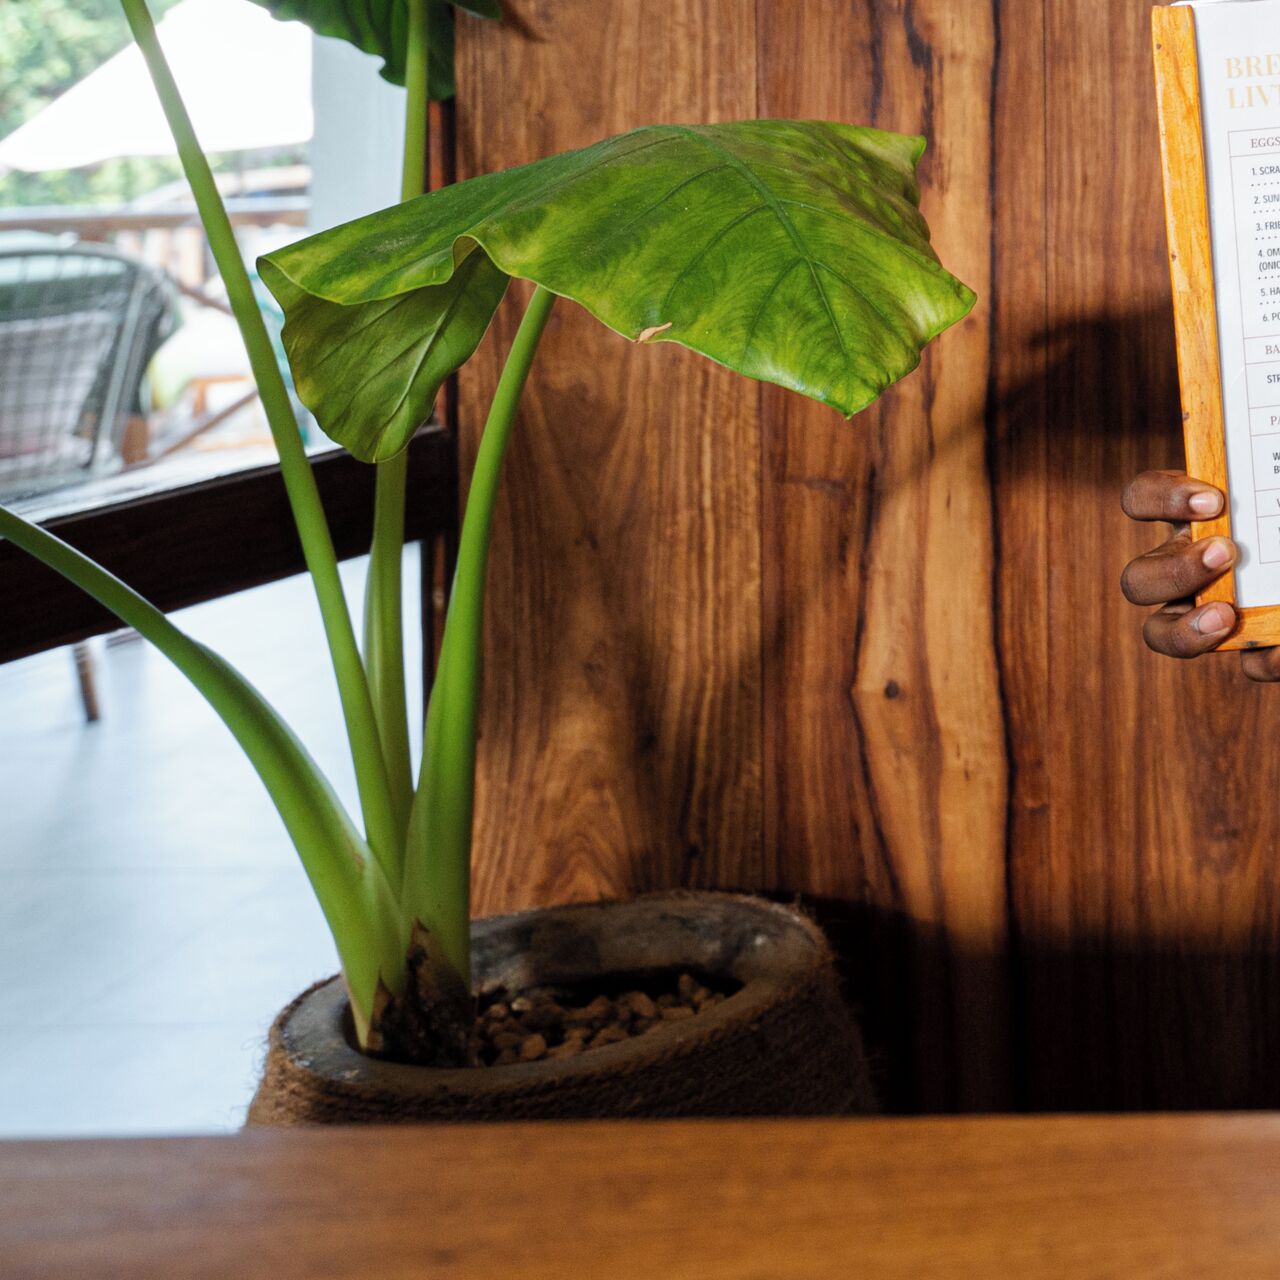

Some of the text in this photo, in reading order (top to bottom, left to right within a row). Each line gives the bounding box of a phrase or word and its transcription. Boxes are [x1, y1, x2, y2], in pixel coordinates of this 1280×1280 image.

[1252, 168, 1257, 176] 1.
[1254, 196, 1260, 204] 2.
[1256, 223, 1263, 231] 3.
[1261, 288, 1267, 296] 5.
[1262, 314, 1269, 322] 6.
